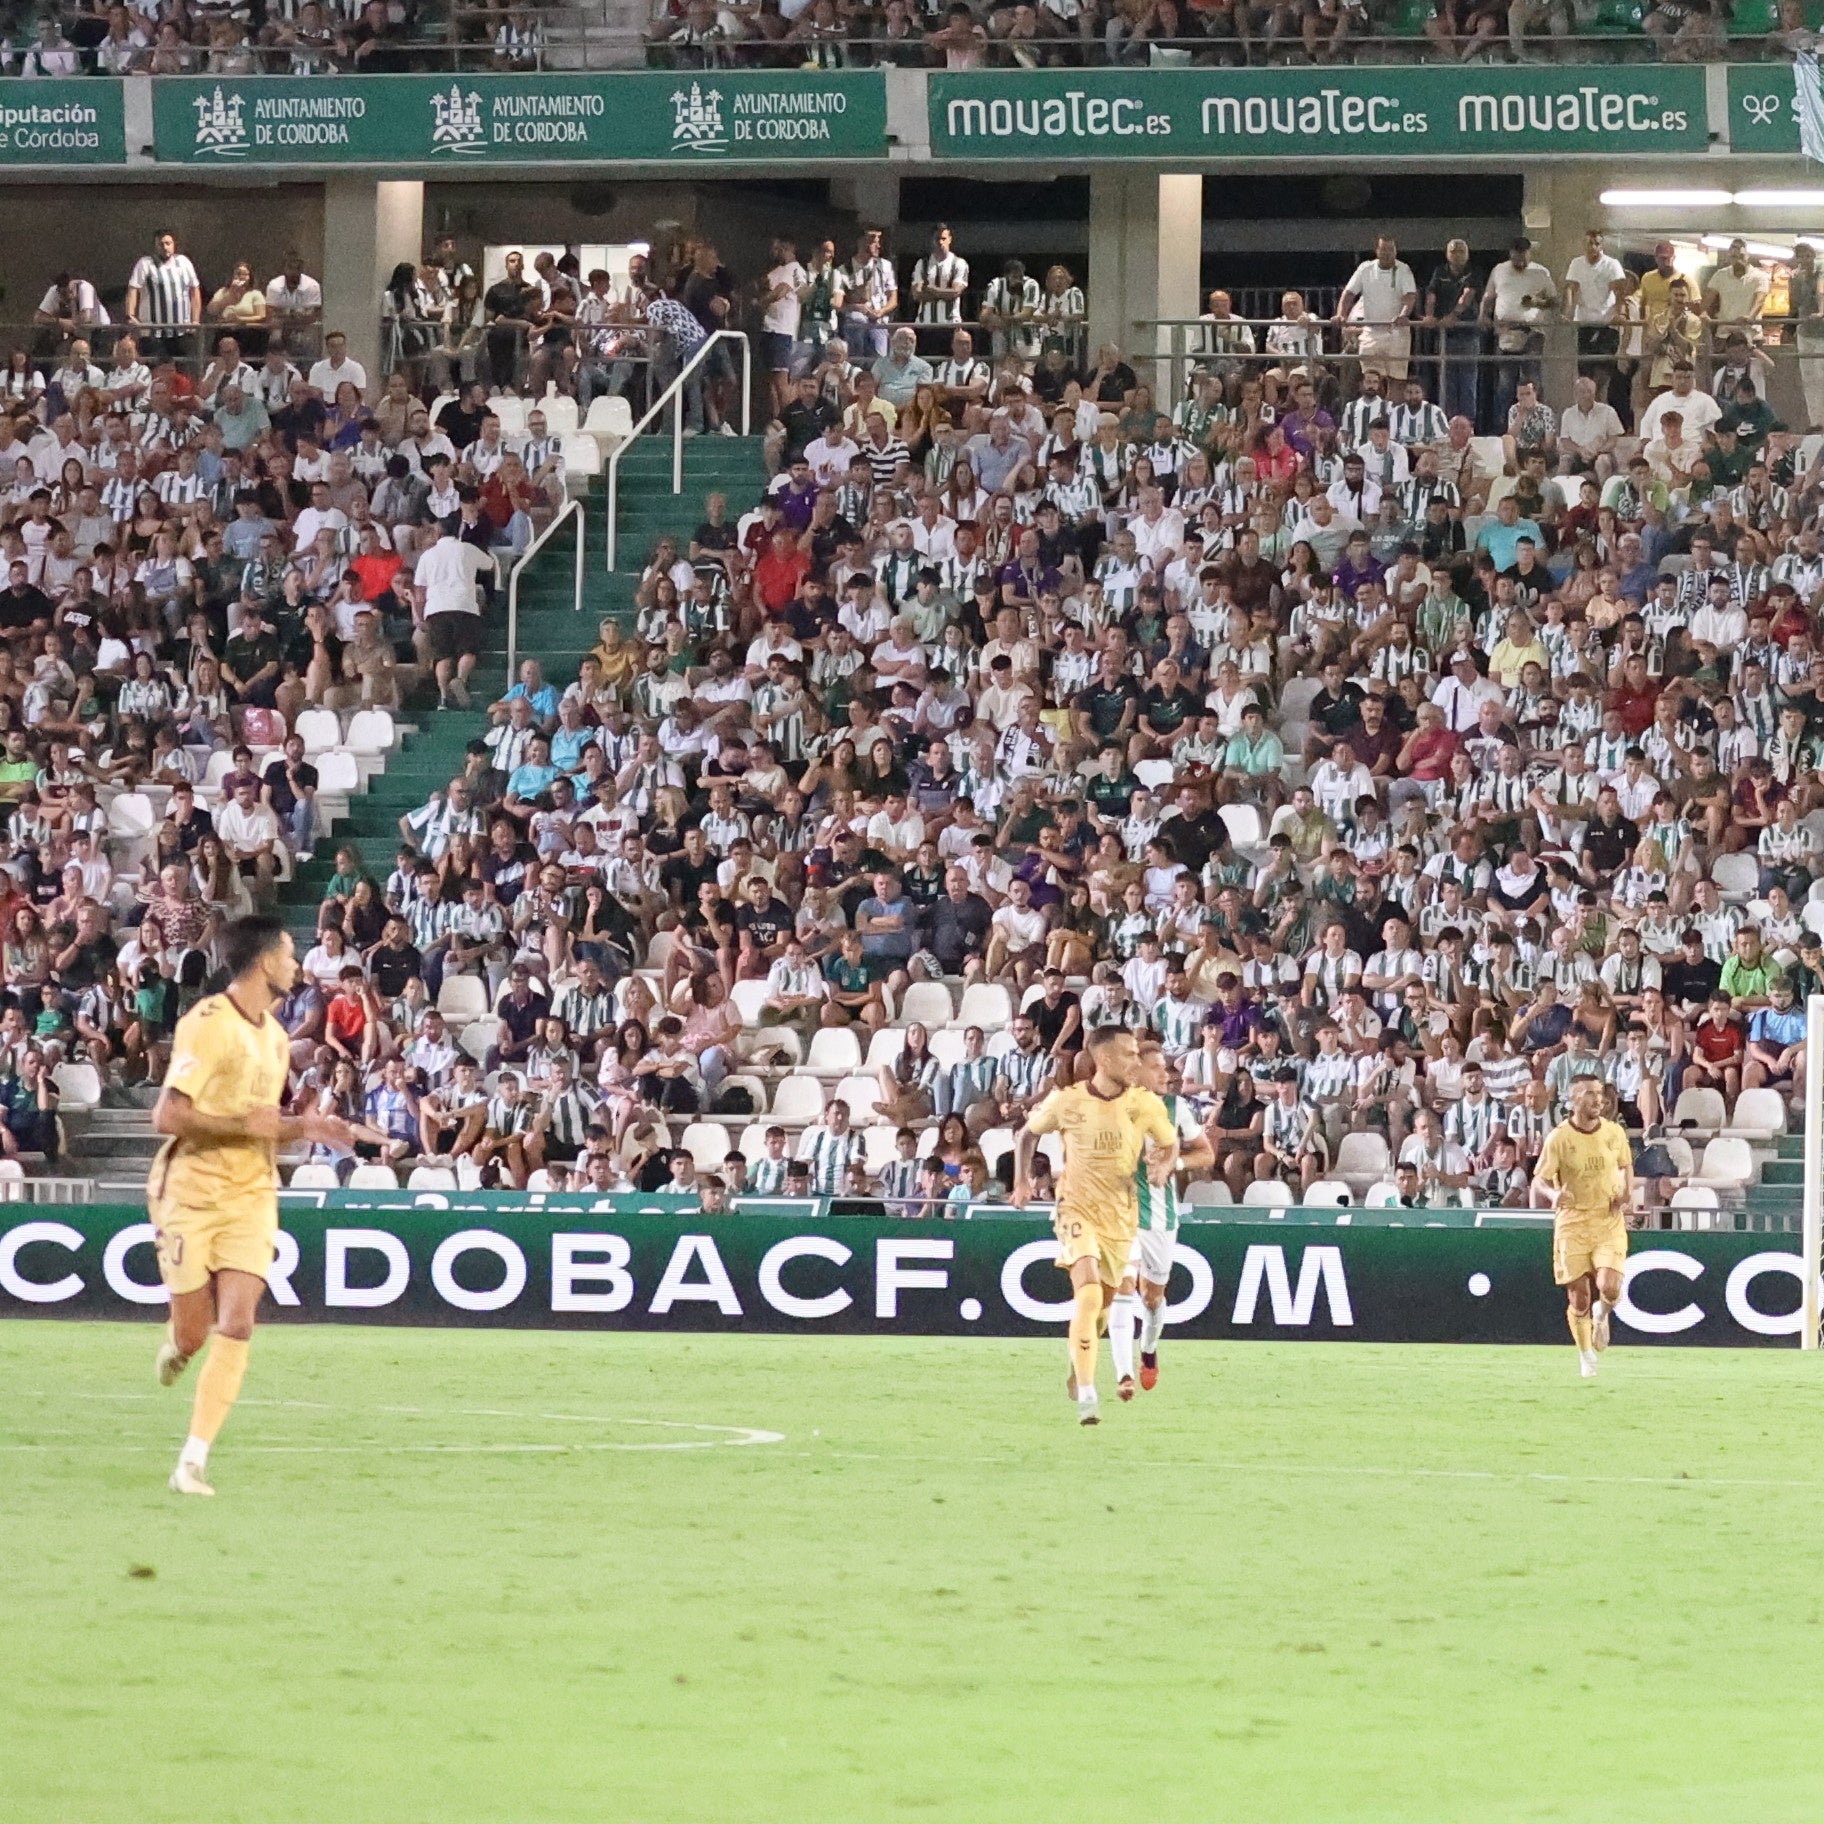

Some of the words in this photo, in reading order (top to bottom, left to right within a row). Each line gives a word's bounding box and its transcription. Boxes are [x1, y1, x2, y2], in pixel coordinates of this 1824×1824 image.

[255, 97, 366, 118] AYUNTAMIENTO
[493, 95, 605, 117] AYUNTAMIENTO
[734, 92, 847, 114] AYUNTAMIENTO
[256, 124, 274, 145] DE
[494, 122, 512, 143] DE
[735, 119, 754, 141] DE
